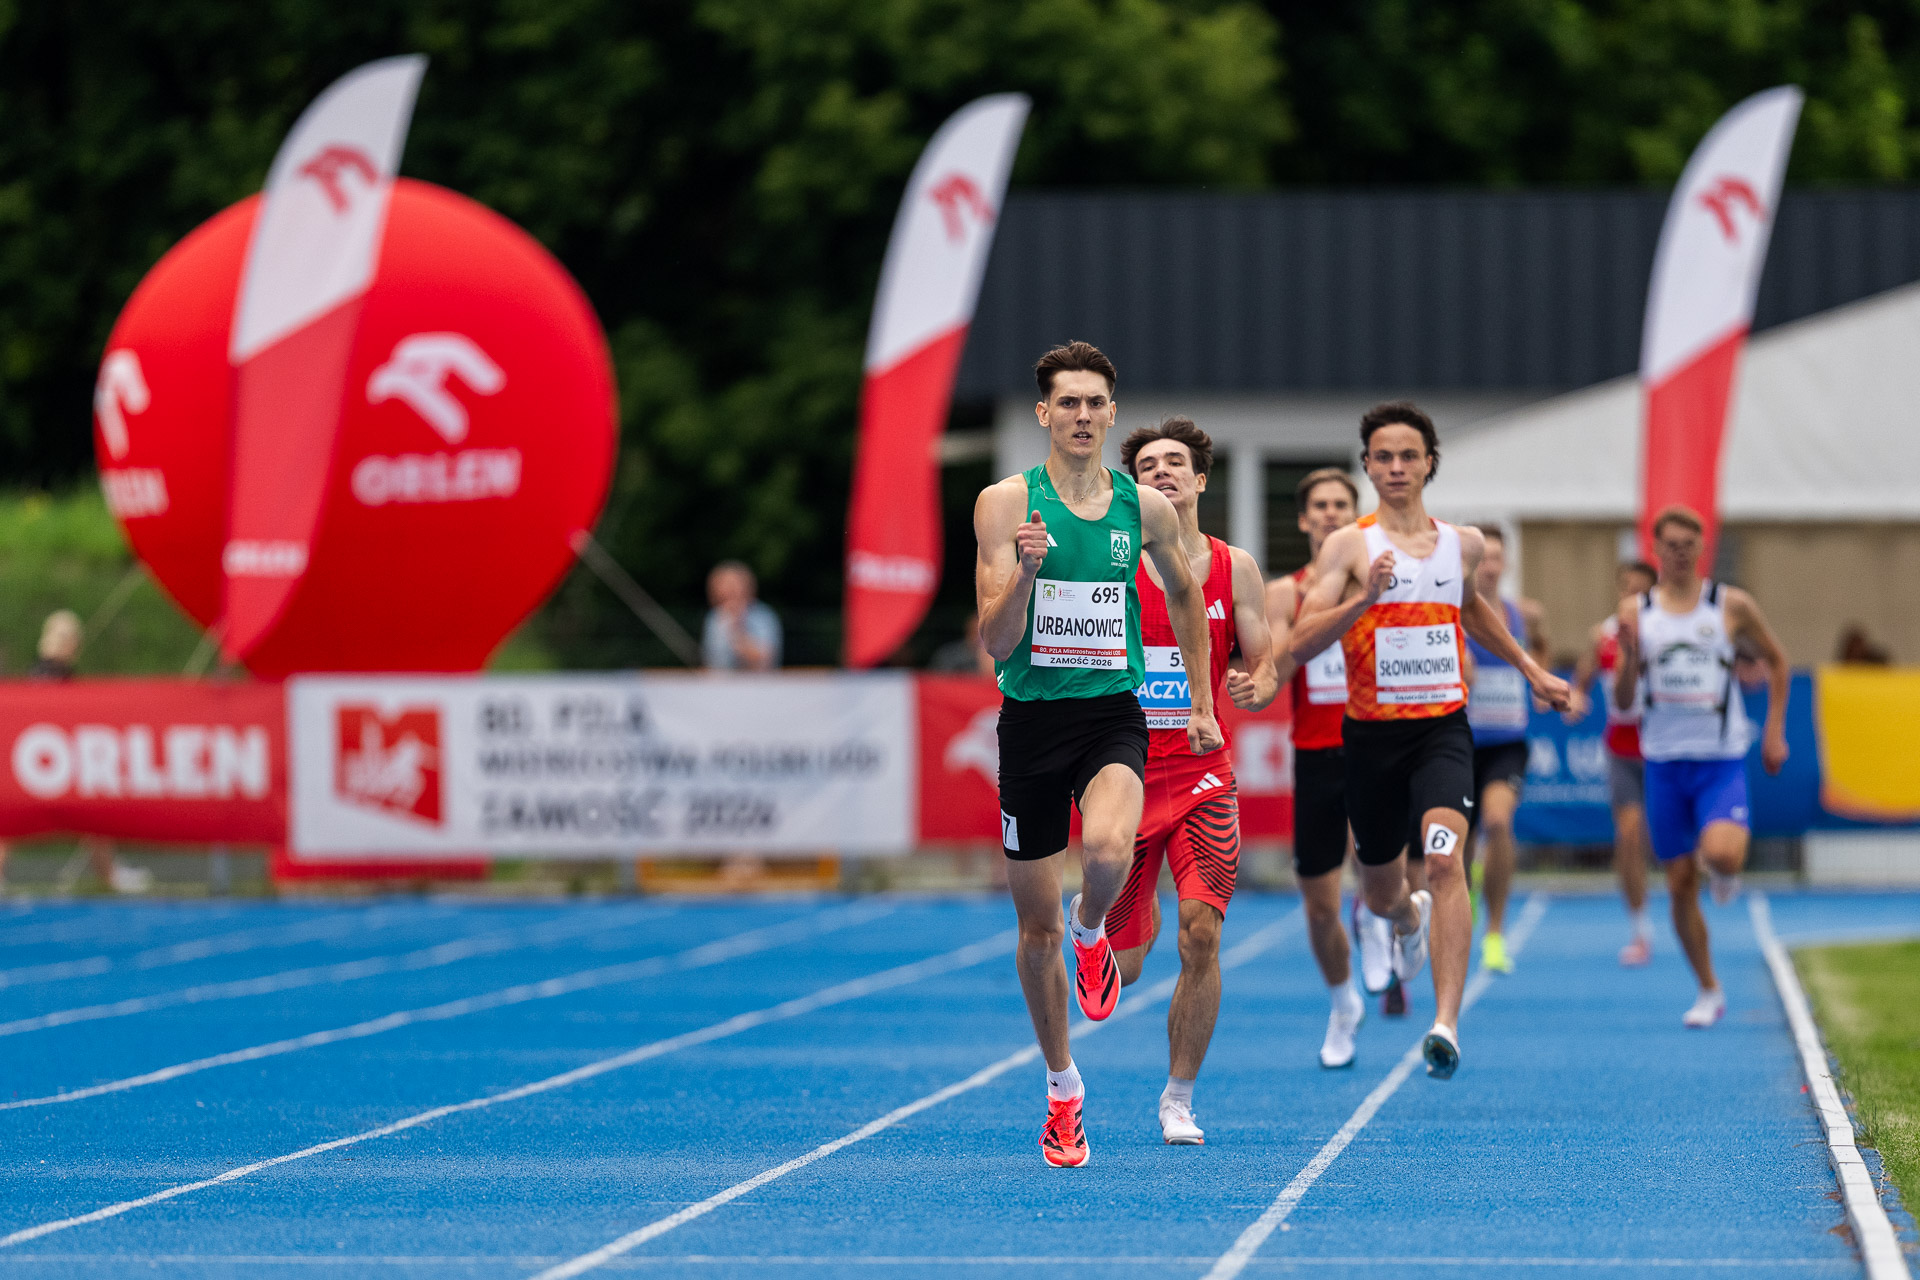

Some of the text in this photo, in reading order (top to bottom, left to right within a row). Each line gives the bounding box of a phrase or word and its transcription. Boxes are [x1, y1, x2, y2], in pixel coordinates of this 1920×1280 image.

[351, 447, 522, 505] ORLEN
[1091, 586, 1119, 604] 695
[1036, 614, 1123, 638] URBANOWICZ
[1426, 629, 1450, 646] 556
[1050, 656, 1113, 666] ZAMOŚĆ 2026
[1063, 648, 1097, 656] Mistrzostwa
[1170, 652, 1186, 667] 5
[1379, 656, 1454, 676] SŁOWIKOWSKI
[1134, 680, 1192, 699] ACZY
[12, 722, 270, 797] ORLEN
[1003, 814, 1011, 844] 7
[1432, 830, 1448, 849] 6
